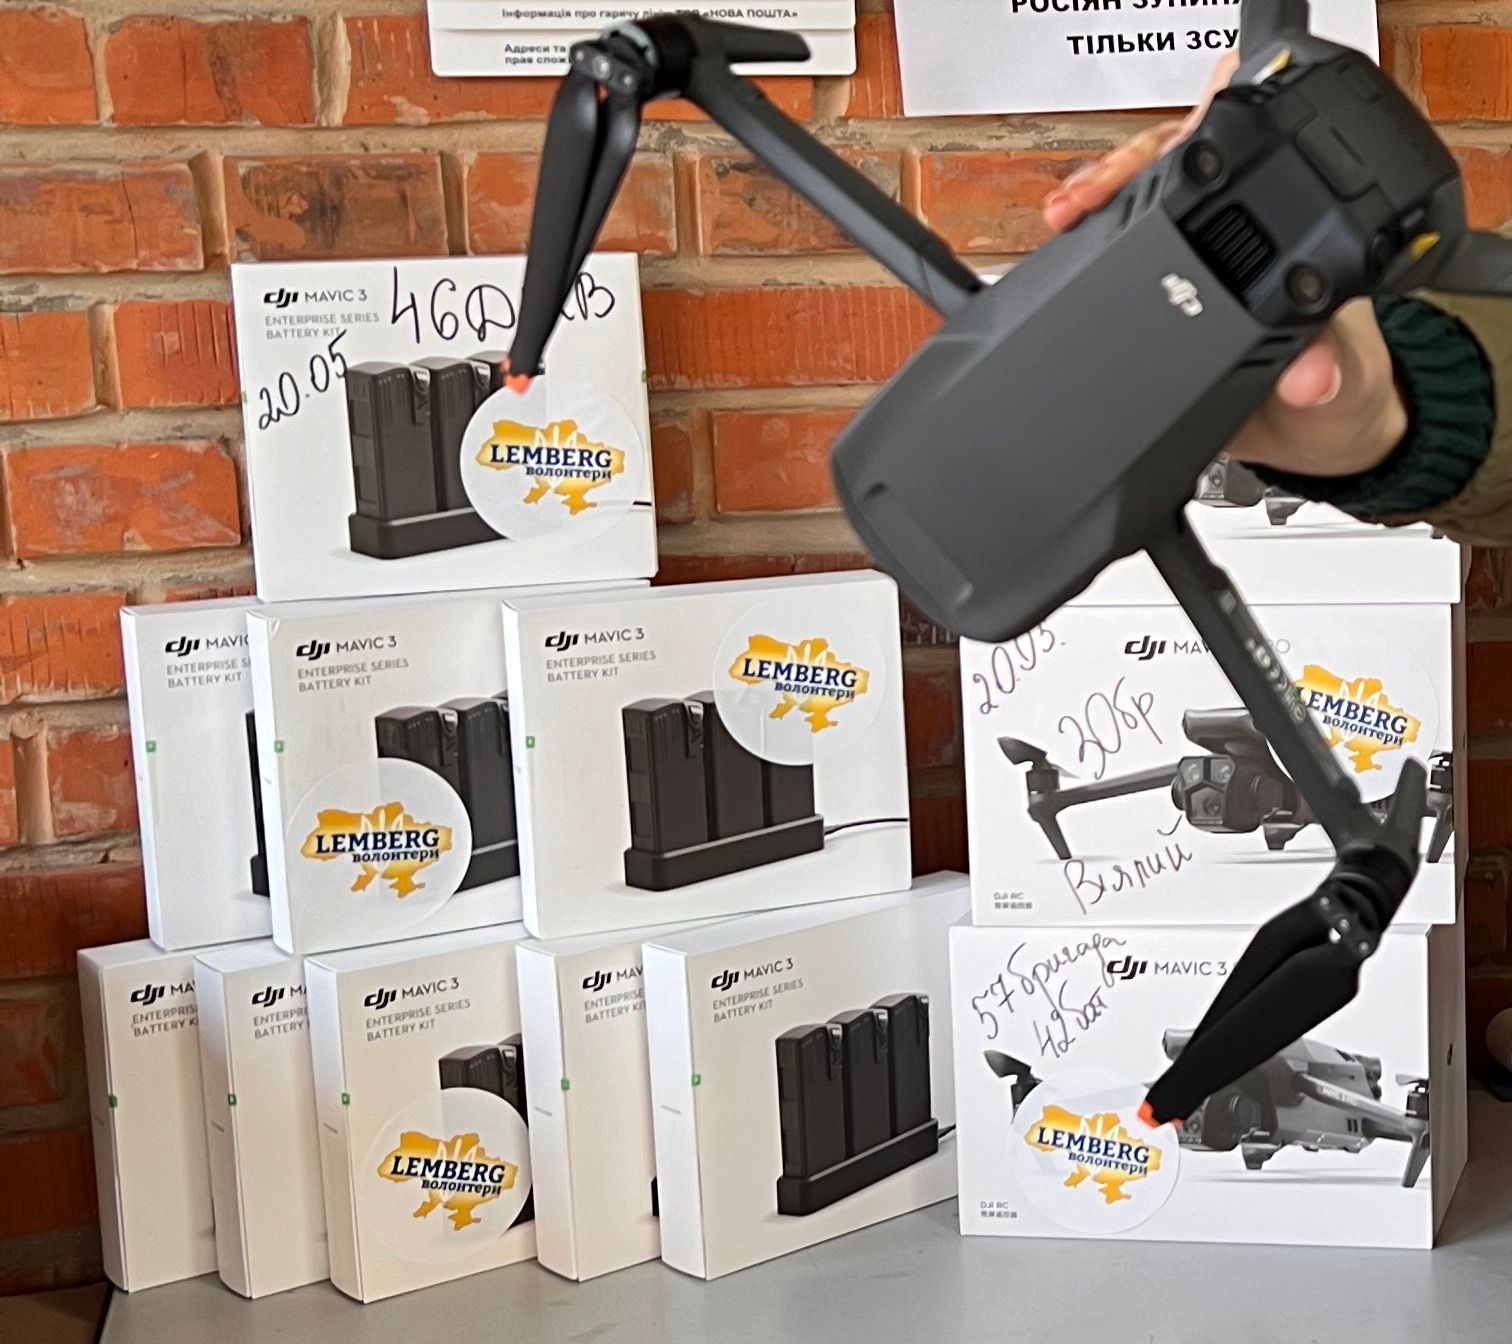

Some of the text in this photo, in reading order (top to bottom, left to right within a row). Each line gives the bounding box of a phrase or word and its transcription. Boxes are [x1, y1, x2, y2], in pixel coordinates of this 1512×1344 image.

[1067, 28, 1239, 55] ТІЛЬКИ ЗСУ
[305, 289, 354, 303] MAVIC
[359, 289, 367, 301] 3
[490, 445, 612, 467] LEMBERG
[526, 466, 611, 482] волонтери
[336, 637, 384, 653] MAVIC
[388, 635, 397, 647] 3
[584, 629, 632, 644] MAVIC
[636, 628, 644, 640] 3
[742, 658, 858, 688] LEMBERG
[774, 682, 855, 701] волонтери
[1323, 716, 1404, 745] волонтери
[315, 829, 439, 854] LEMBERG
[352, 848, 439, 863] волонтери
[744, 960, 783, 980] MAVIC
[786, 958, 793, 970] 3
[1155, 961, 1211, 976] MAVIC
[1217, 961, 1227, 976] 3
[402, 980, 447, 999] MAVIC
[451, 976, 459, 989] 3
[1038, 1126, 1150, 1164] LEMBERG
[391, 1156, 505, 1184] LEMBERG
[1069, 1150, 1147, 1177] волонтери
[422, 1179, 501, 1196] волонтери
